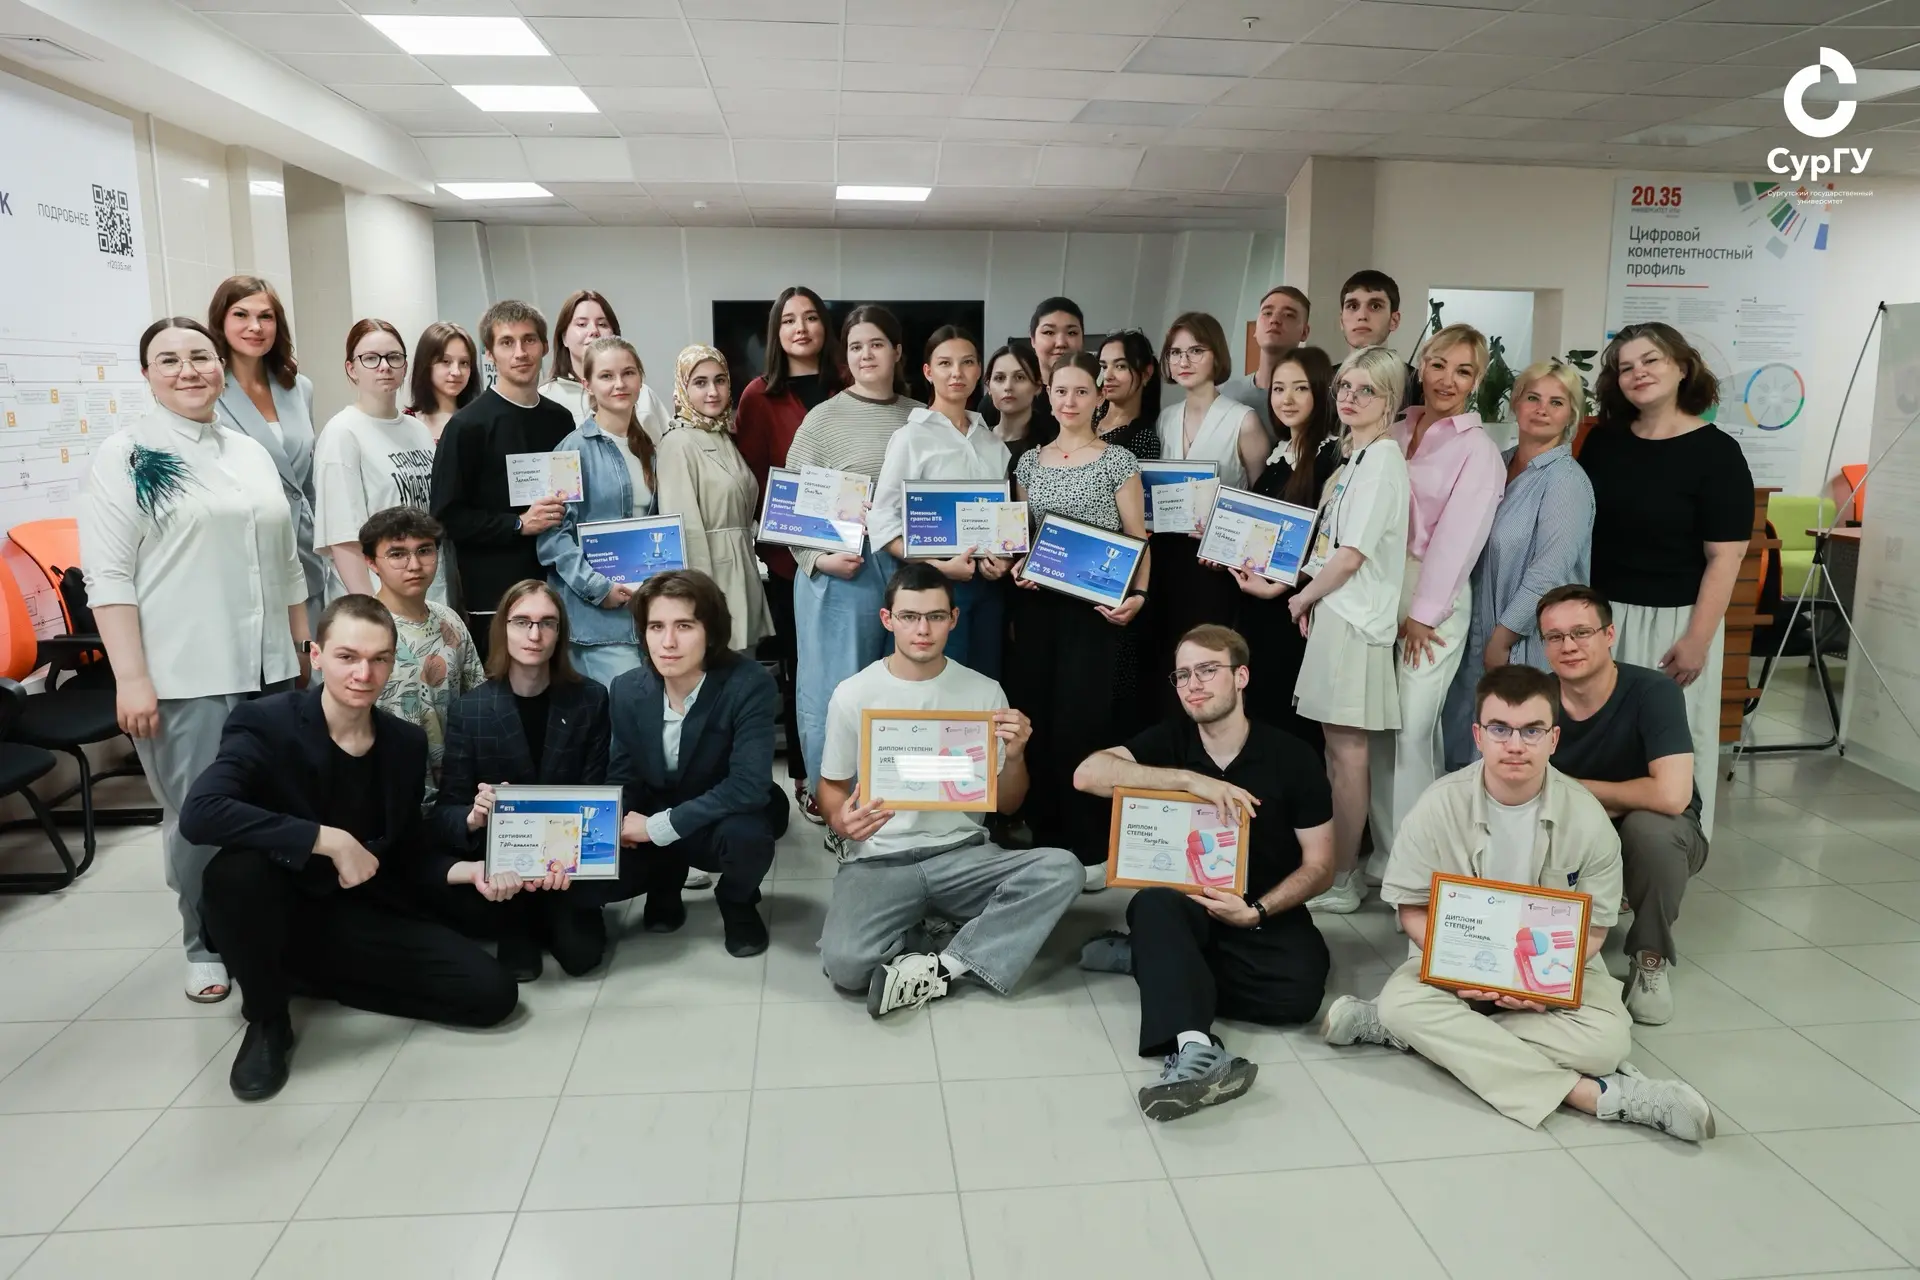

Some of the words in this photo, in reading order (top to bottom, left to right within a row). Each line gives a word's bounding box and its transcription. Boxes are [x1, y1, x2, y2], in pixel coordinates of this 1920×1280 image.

[1631, 186, 1682, 206] 20.35
[38, 203, 90, 226] ПОДРОБНЕЕ
[1629, 226, 1700, 244] Цифровой
[1628, 245, 1753, 260] компетентностный
[1627, 262, 1686, 277] профиль
[772, 497, 796, 505] Именны
[1038, 546, 1057, 554] гранты
[1040, 540, 1065, 551] Именные
[1042, 566, 1050, 574] 75
[1051, 570, 1065, 578] 000
[1127, 823, 1153, 831] ДИПЛОМ
[1445, 914, 1476, 924] ДИПЛОМ
[1444, 921, 1475, 932] СТЕПЕНИ
